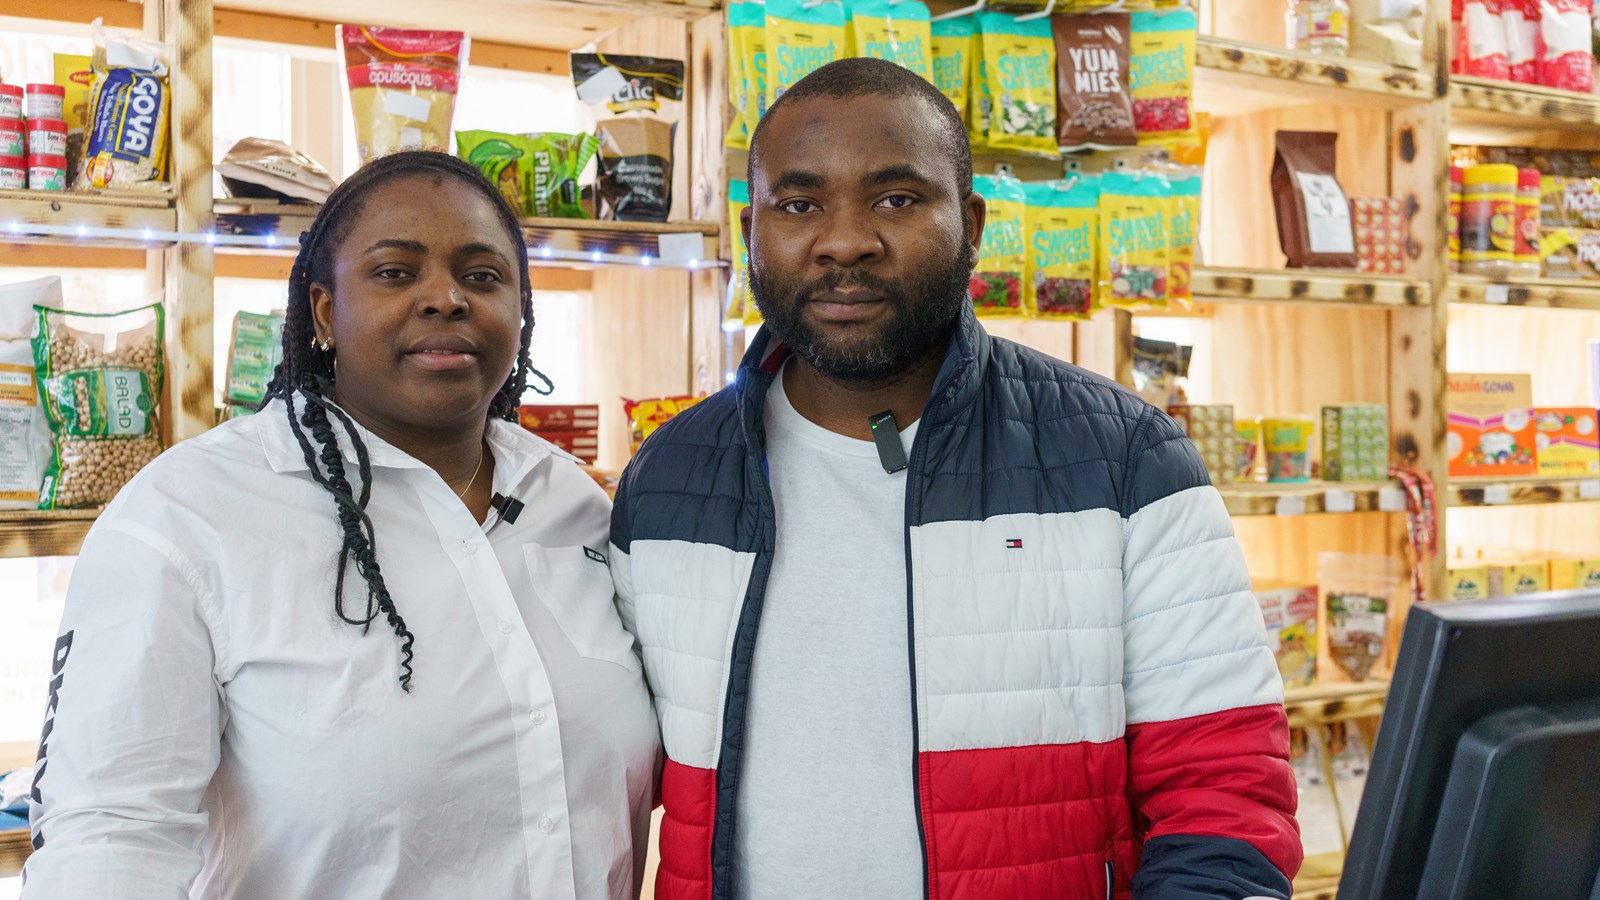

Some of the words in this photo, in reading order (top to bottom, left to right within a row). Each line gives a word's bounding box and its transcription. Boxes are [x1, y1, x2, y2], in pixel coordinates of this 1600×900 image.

[369, 71, 432, 86] COUSCOUS
[777, 39, 835, 84] Sweet
[932, 50, 962, 80] eet
[999, 49, 1049, 91] Sweet
[1068, 47, 1119, 72] YUM
[1074, 71, 1121, 93] MIES
[124, 77, 158, 152] GOYA
[1034, 221, 1089, 267] Sweet
[1109, 210, 1164, 255] Sweet
[114, 375, 132, 429] BALAD
